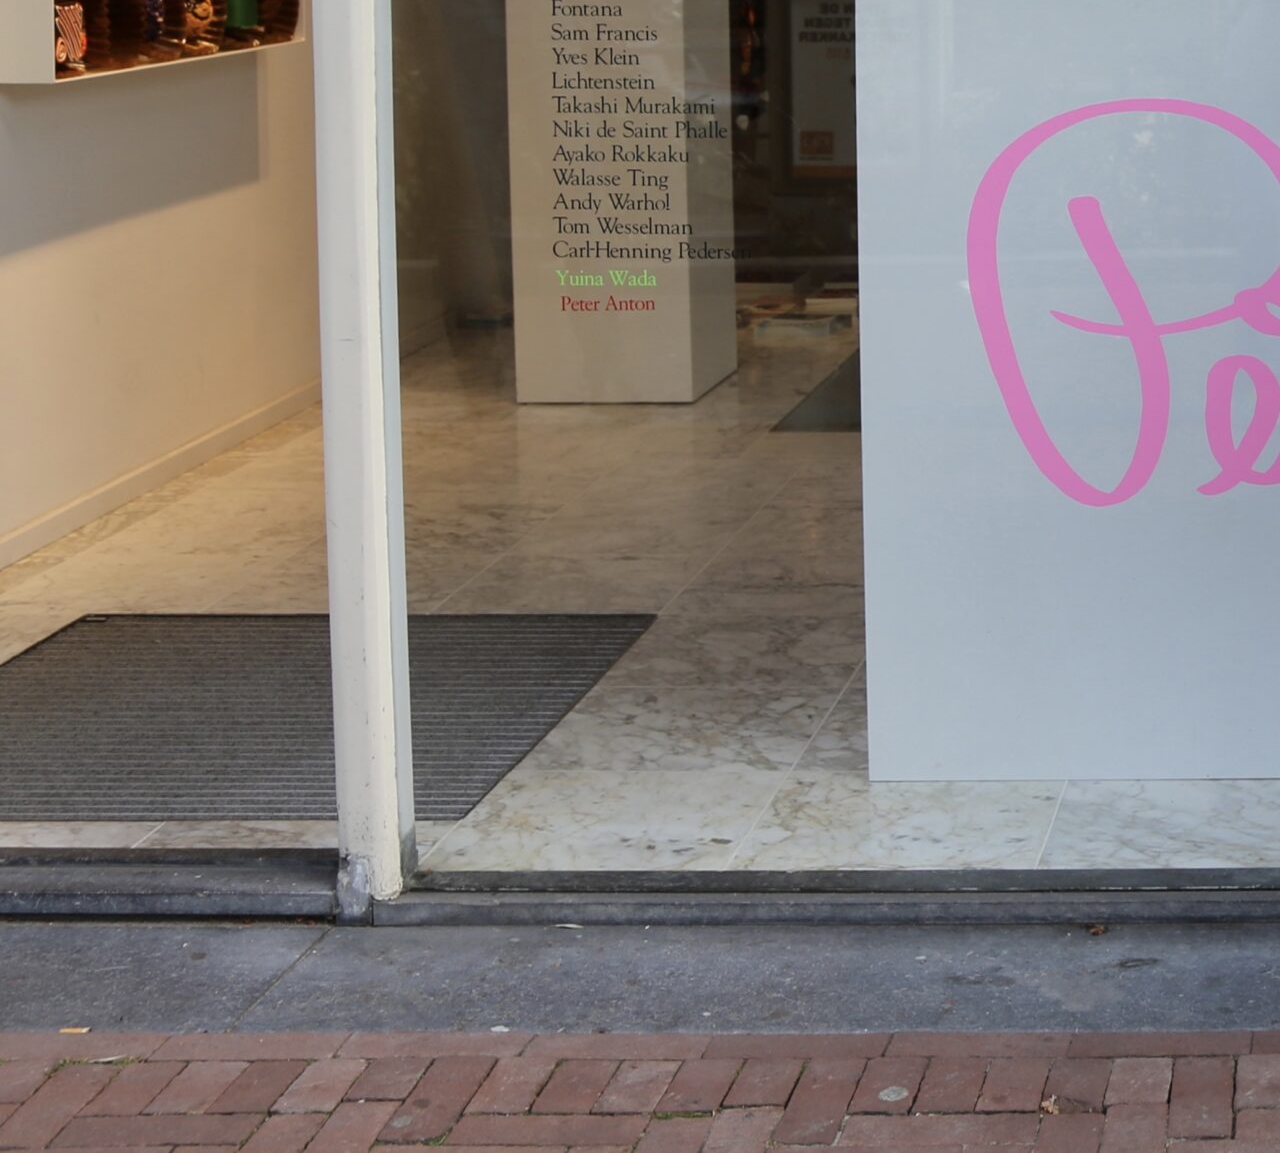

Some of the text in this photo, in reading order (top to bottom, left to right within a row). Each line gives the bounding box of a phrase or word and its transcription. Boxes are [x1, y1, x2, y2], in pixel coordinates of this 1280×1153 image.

[552, 0, 623, 17] Fontana
[551, 23, 658, 41] Sam Francis
[552, 48, 640, 65] Yves Klein
[552, 72, 655, 90] Lichtenstein
[552, 96, 716, 115] Takashi Murakami
[553, 121, 728, 139] Niki de Saint Phalle
[552, 145, 689, 165] Ayako Rokkaku
[553, 169, 669, 190] Walasse Ting
[553, 193, 602, 214] Andy
[553, 217, 693, 235] Tom Wesselman
[552, 241, 752, 262] Carl-Henning Pedersen
[556, 269, 657, 286] Yuina Wada
[561, 296, 656, 312] Peter Anton
